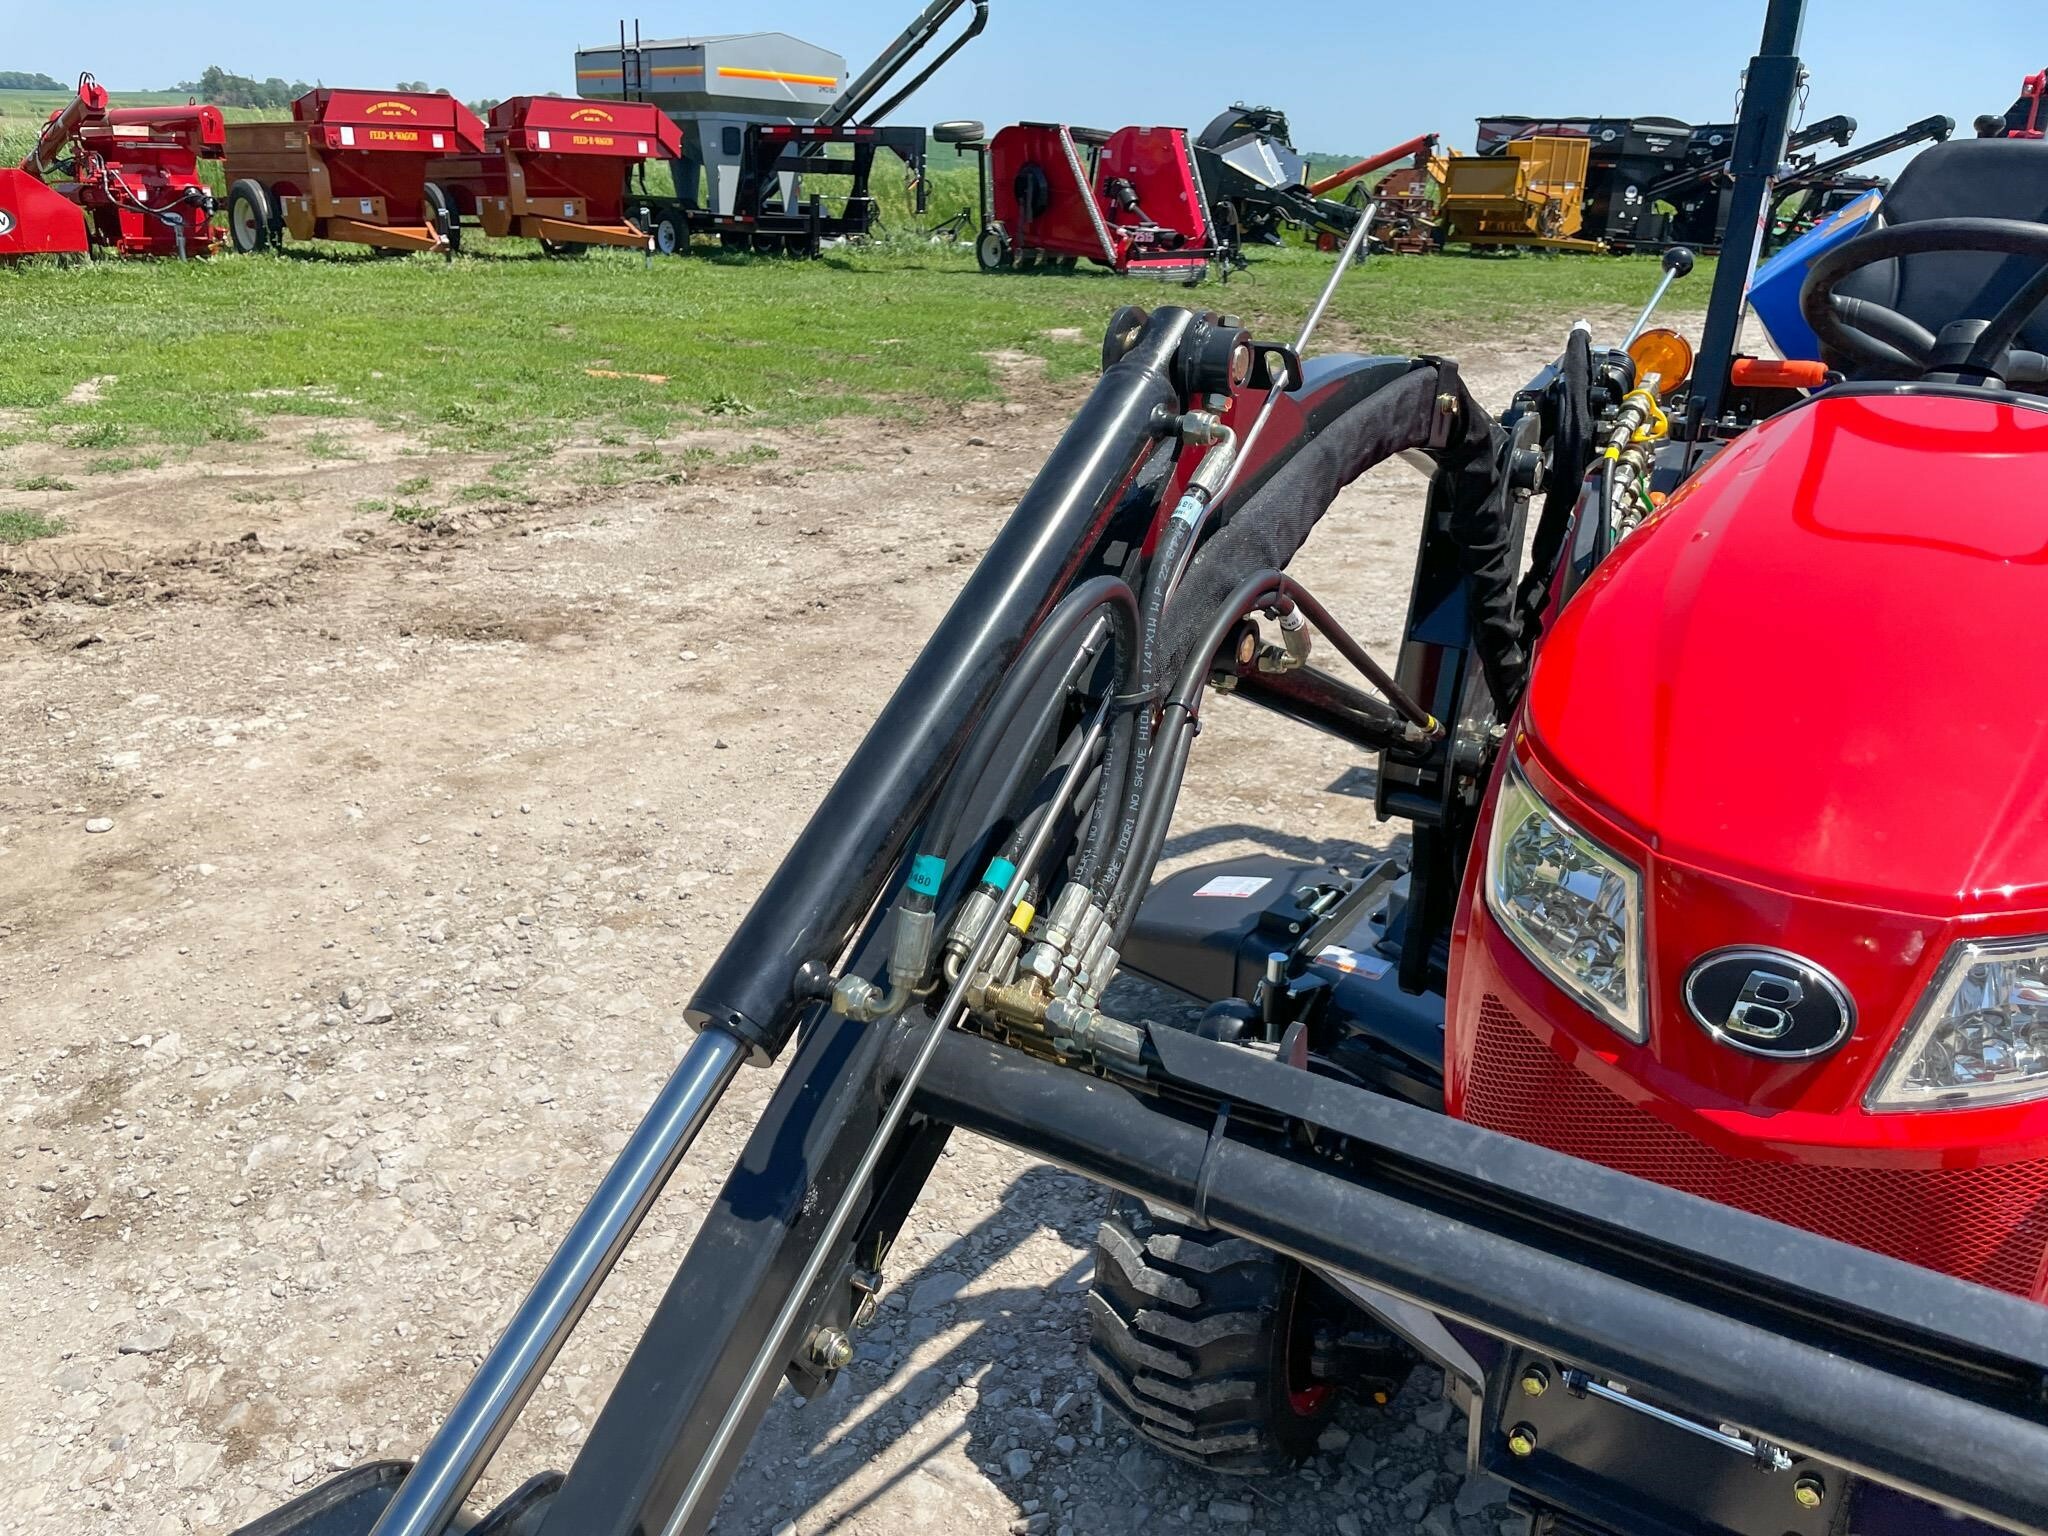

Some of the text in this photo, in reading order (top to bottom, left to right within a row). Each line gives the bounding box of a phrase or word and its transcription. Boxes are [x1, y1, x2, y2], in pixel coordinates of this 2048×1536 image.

[1128, 793, 1140, 811] NO
[1134, 747, 1147, 788] SKIVE
[1087, 825, 1098, 841] NO
[1725, 969, 1804, 1039] B
